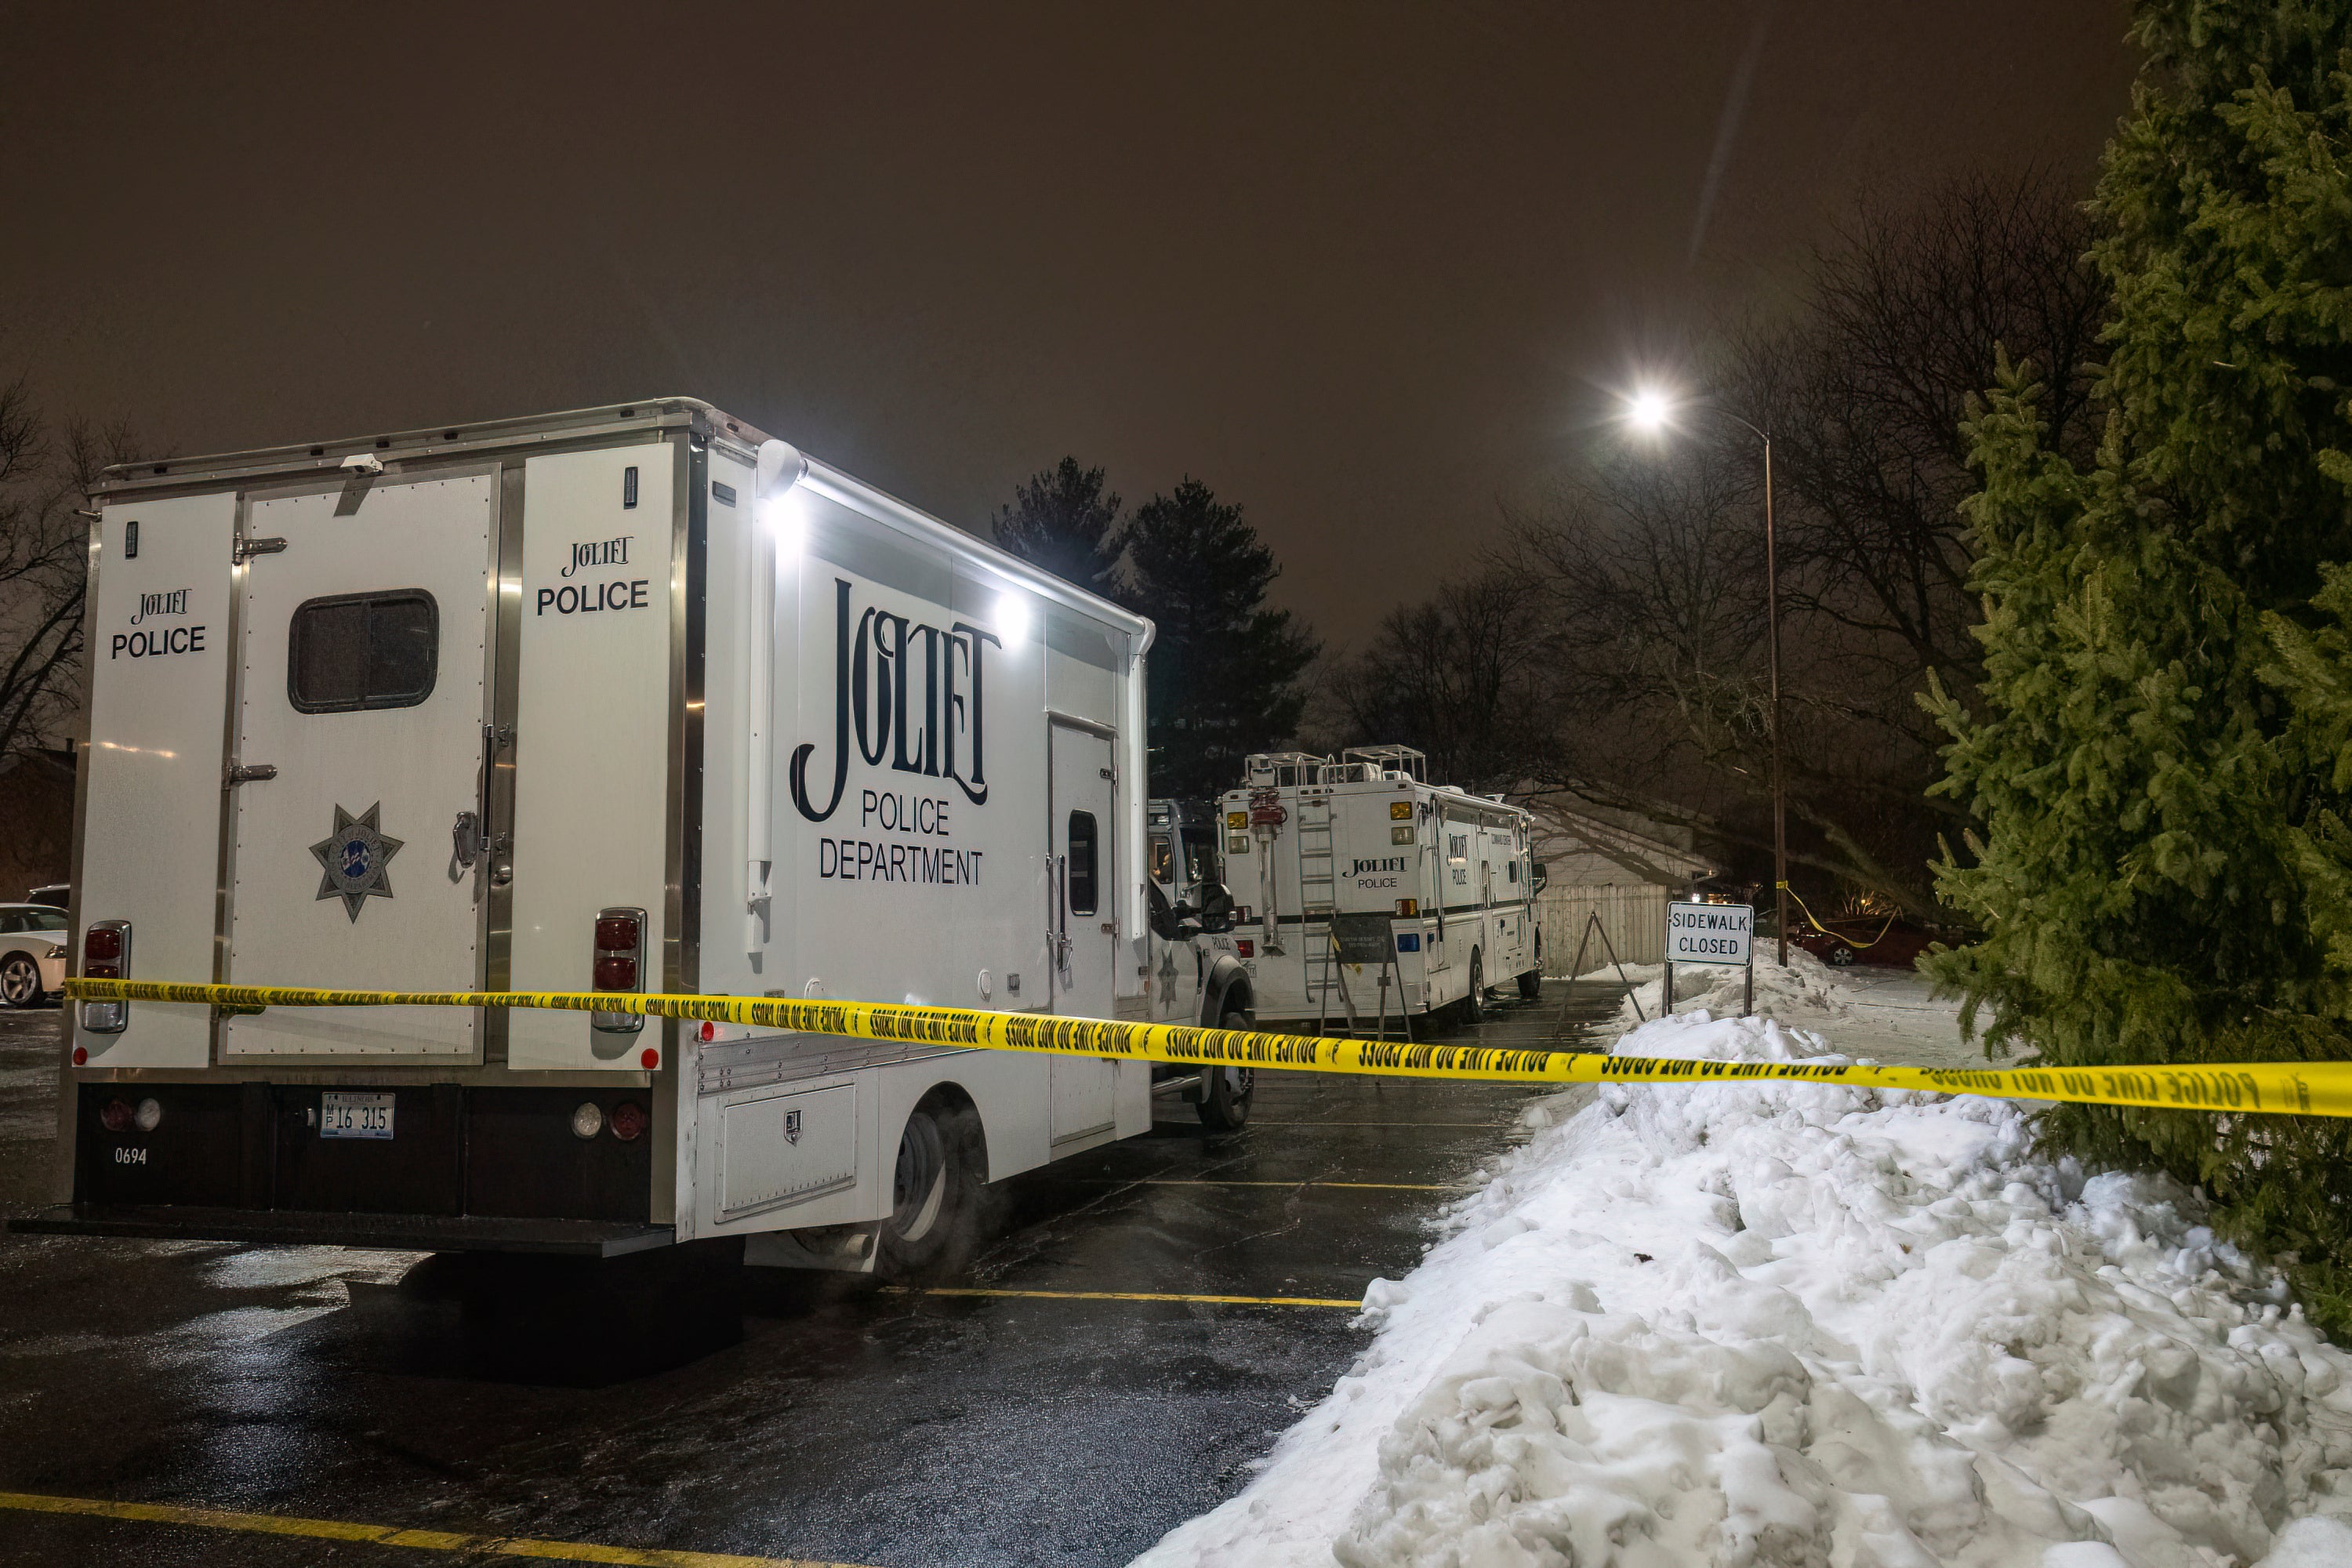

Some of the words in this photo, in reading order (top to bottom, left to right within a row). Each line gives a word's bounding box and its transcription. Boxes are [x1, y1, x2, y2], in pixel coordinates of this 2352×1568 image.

[561, 536, 633, 577] JOLIET
[130, 588, 194, 625] JOLIET
[537, 580, 649, 616] POLICE
[111, 626, 206, 659] POLICE
[789, 577, 1002, 823] JOLIET
[862, 789, 950, 837] POLICE
[820, 837, 983, 886] DEPARTMENT
[1446, 833, 1468, 866] JOLIET
[1342, 856, 1412, 878] JOLIET
[1452, 869, 1467, 885] POLICE
[1358, 878, 1397, 889] POLICE
[1672, 913, 1748, 931] SIDEWALK
[1679, 937, 1739, 955] CLOSED
[752, 1002, 776, 1026] CROSS
[777, 1004, 790, 1028] NOT
[791, 1004, 803, 1029] DO
[803, 1005, 820, 1031] LINE
[820, 1006, 847, 1033] POLICE
[870, 1009, 897, 1038] CROSS
[898, 1011, 915, 1039] NOT
[915, 1011, 928, 1040] DO
[928, 1013, 948, 1041] LINE
[948, 1014, 980, 1044] POLICE
[1006, 1018, 1037, 1047] CROSS
[1037, 1020, 1058, 1048] NOT
[1058, 1022, 1073, 1050] DO
[1073, 1023, 1097, 1051] LINE
[1097, 1023, 1136, 1053] POLICE
[1166, 1029, 1203, 1058] CROSS
[1204, 1031, 1228, 1059] NOT
[1228, 1032, 1247, 1060] DO
[1247, 1034, 1276, 1061] LINE
[1276, 1038, 1320, 1063] POLICE
[336, 1107, 353, 1129] 16
[362, 1107, 386, 1129] 315
[114, 1146, 147, 1165] 0694
